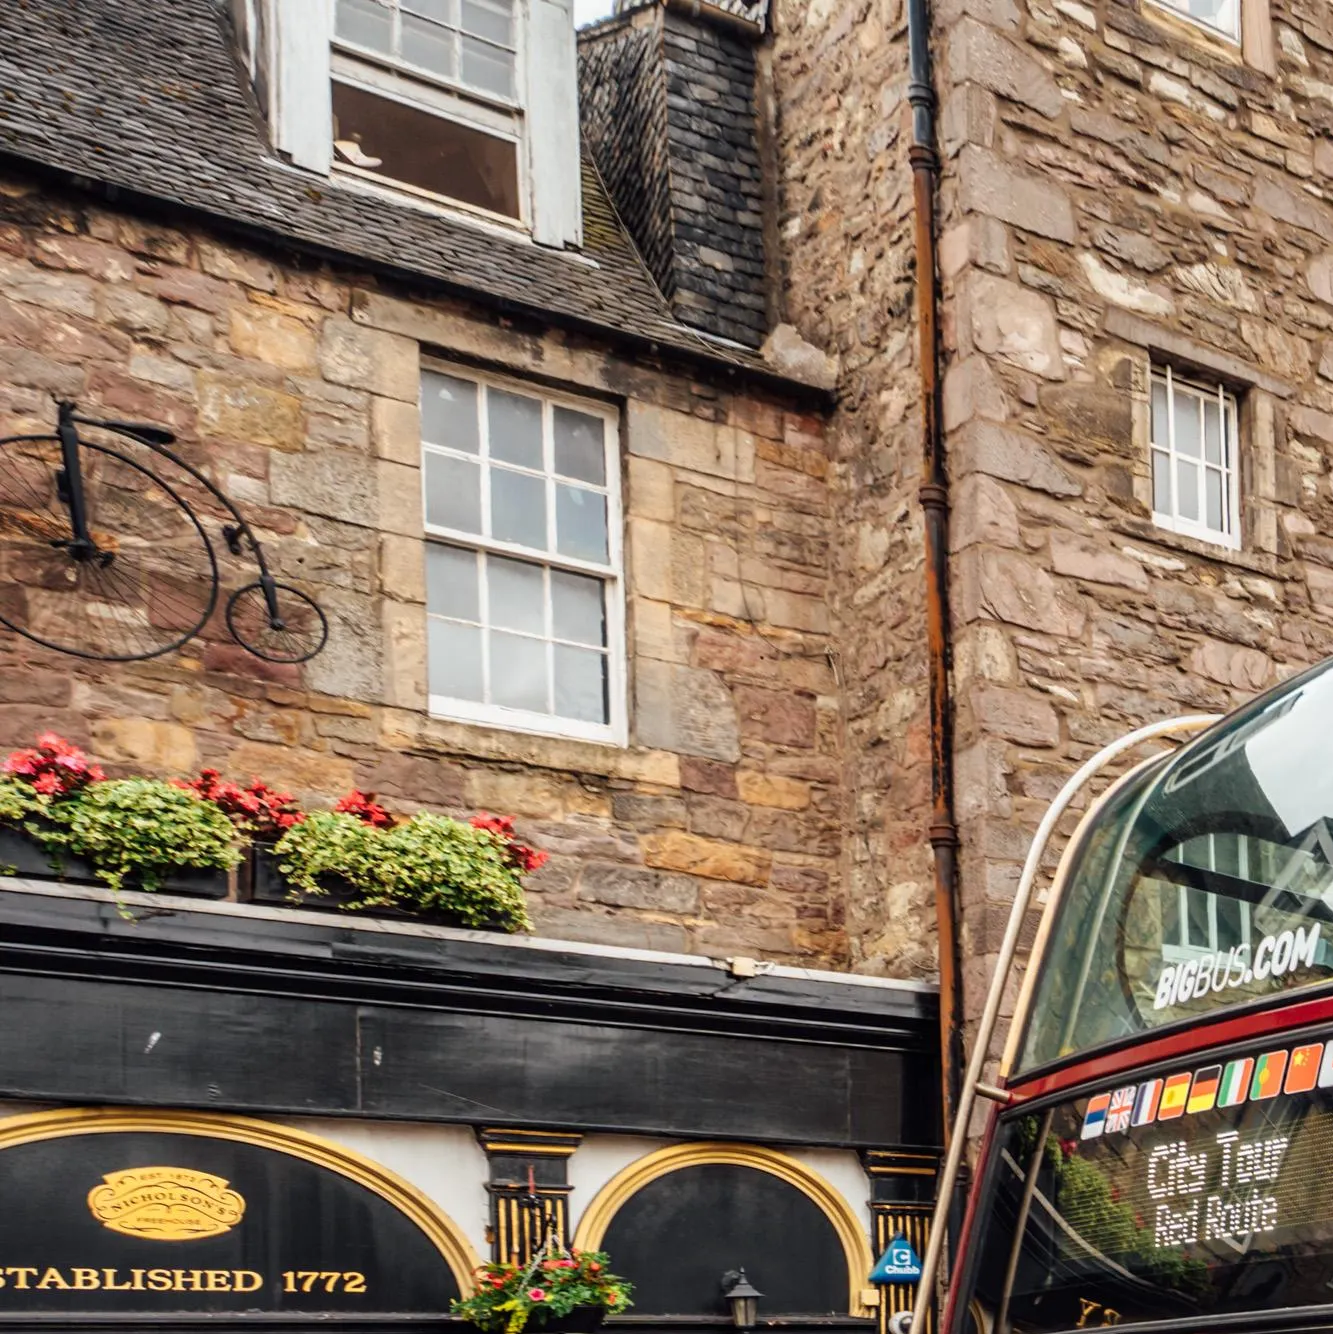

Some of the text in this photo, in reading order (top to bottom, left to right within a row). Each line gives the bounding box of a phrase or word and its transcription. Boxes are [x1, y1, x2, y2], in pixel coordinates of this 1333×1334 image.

[1153, 922, 1321, 1010] BIGBUS.COM
[1148, 1130, 1288, 1199] City Tour
[1155, 1188, 1278, 1248] Red Route
[0, 1267, 367, 1293] TABLISHED 1772
